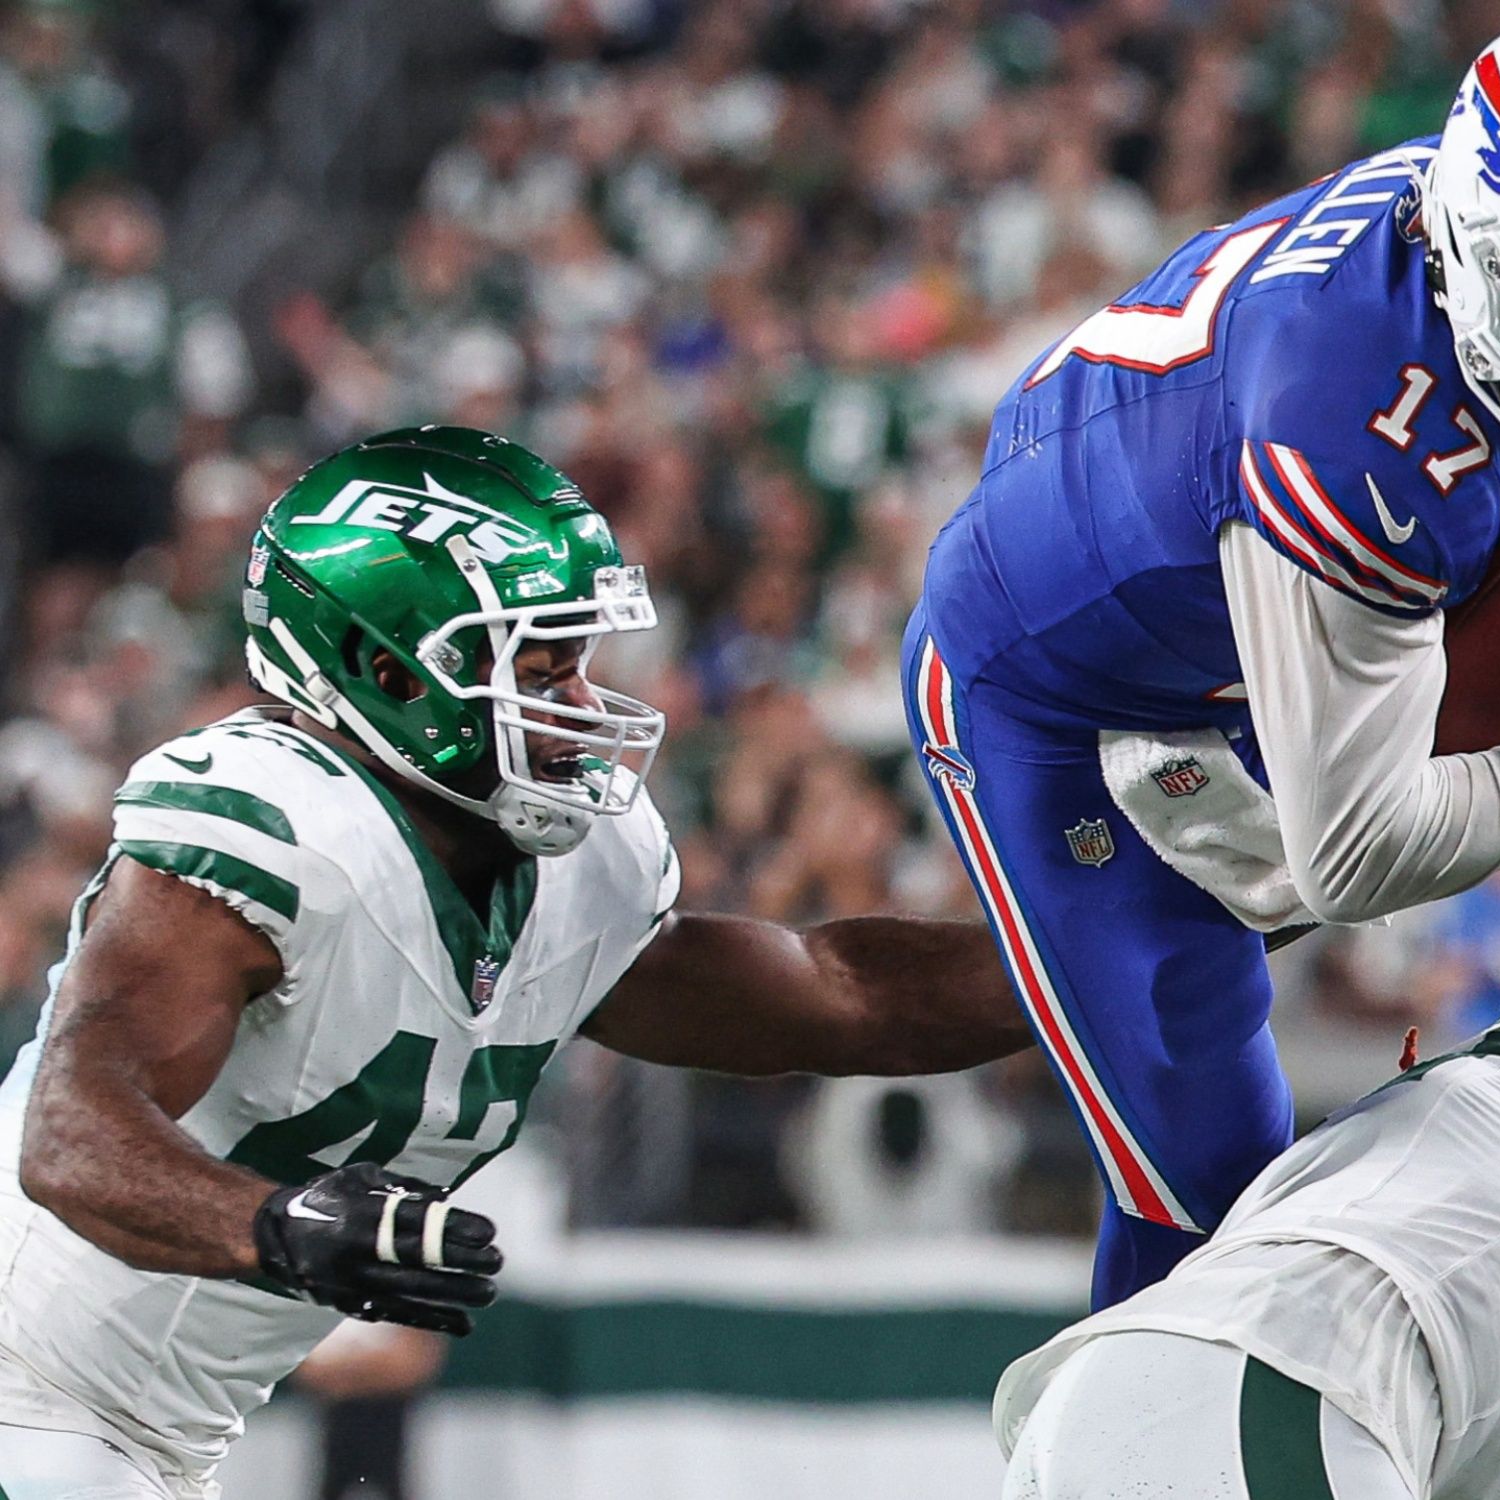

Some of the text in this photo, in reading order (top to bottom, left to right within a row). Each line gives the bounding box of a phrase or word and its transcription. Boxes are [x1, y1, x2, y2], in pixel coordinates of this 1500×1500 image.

[1367, 364, 1492, 496] 17
[290, 471, 540, 565] JETS
[1160, 768, 1206, 795] NFL
[1077, 839, 1109, 859] NFL
